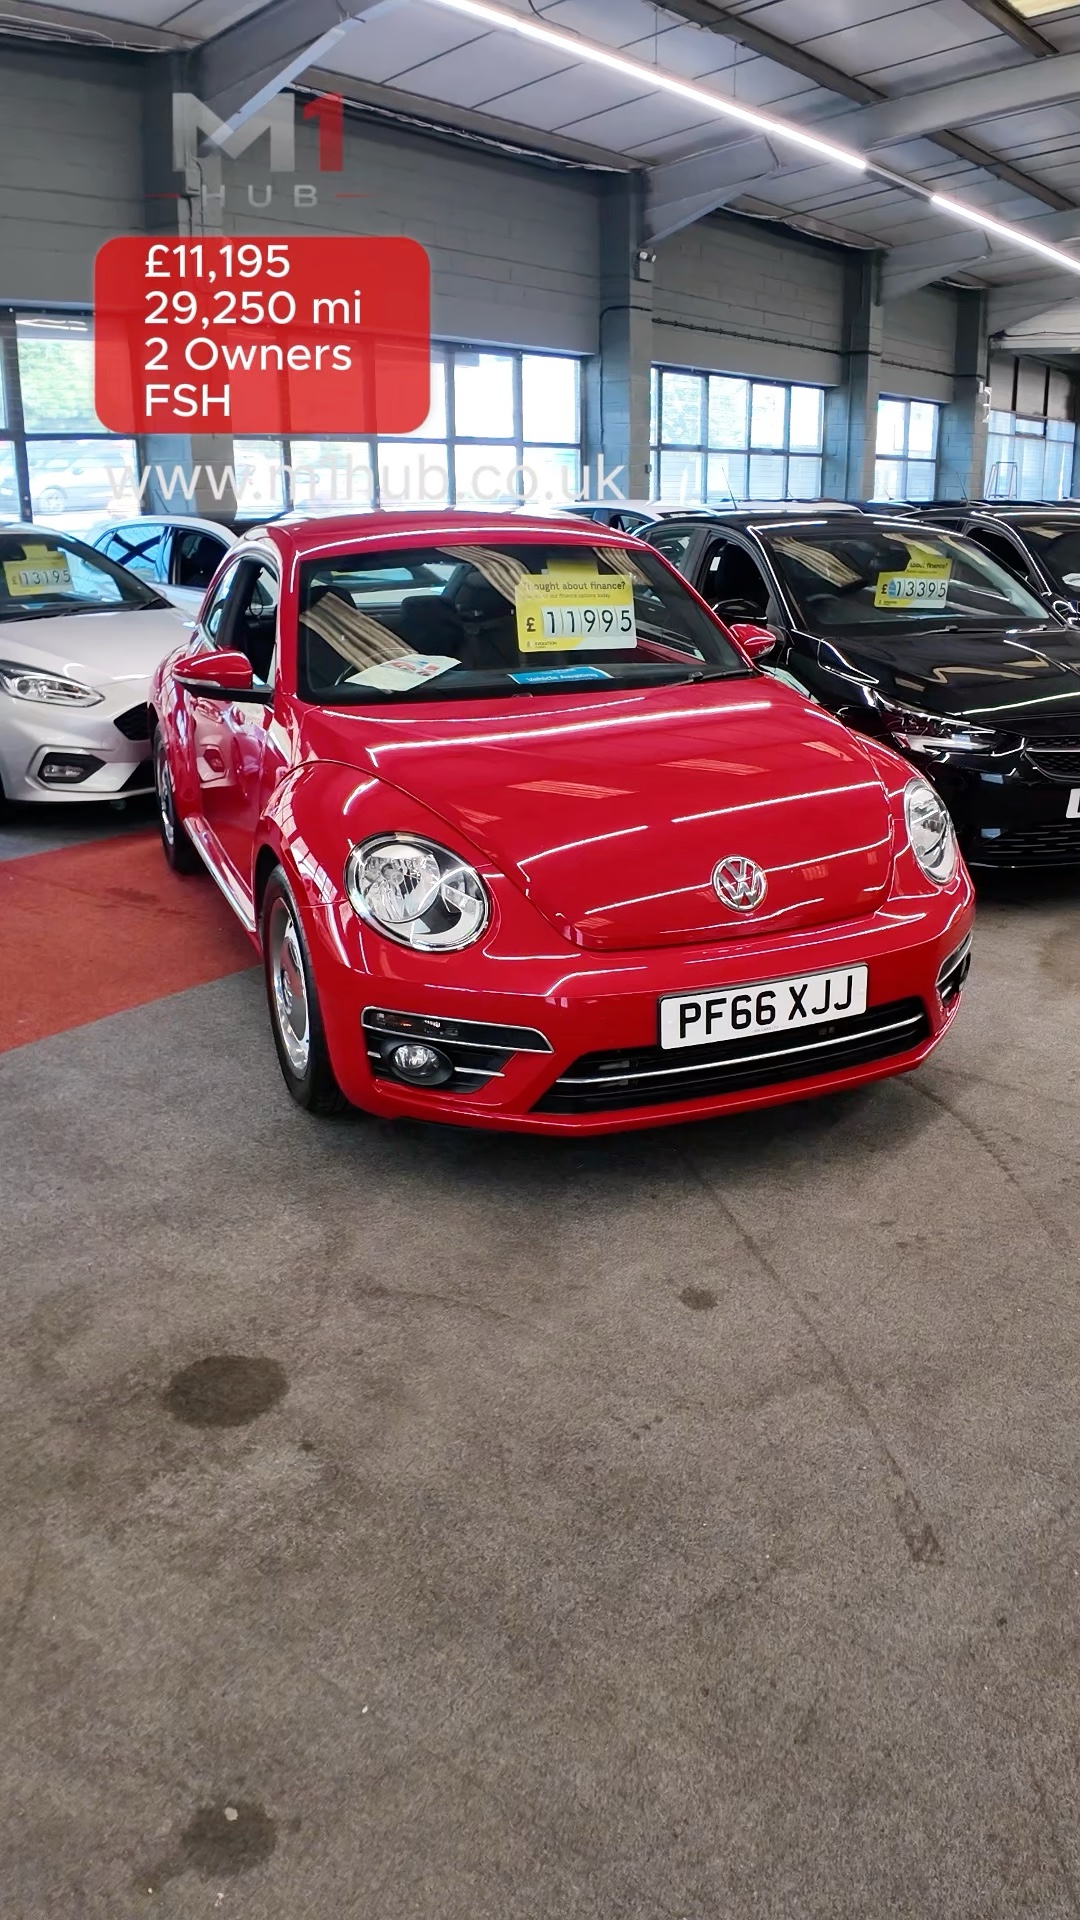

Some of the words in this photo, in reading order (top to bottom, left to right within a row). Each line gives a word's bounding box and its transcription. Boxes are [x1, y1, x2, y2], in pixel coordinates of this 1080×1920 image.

[562, 582, 587, 590] about
[590, 581, 626, 590] finance?
[680, 990, 776, 1039] PF66
[787, 974, 853, 1021] XJJ
